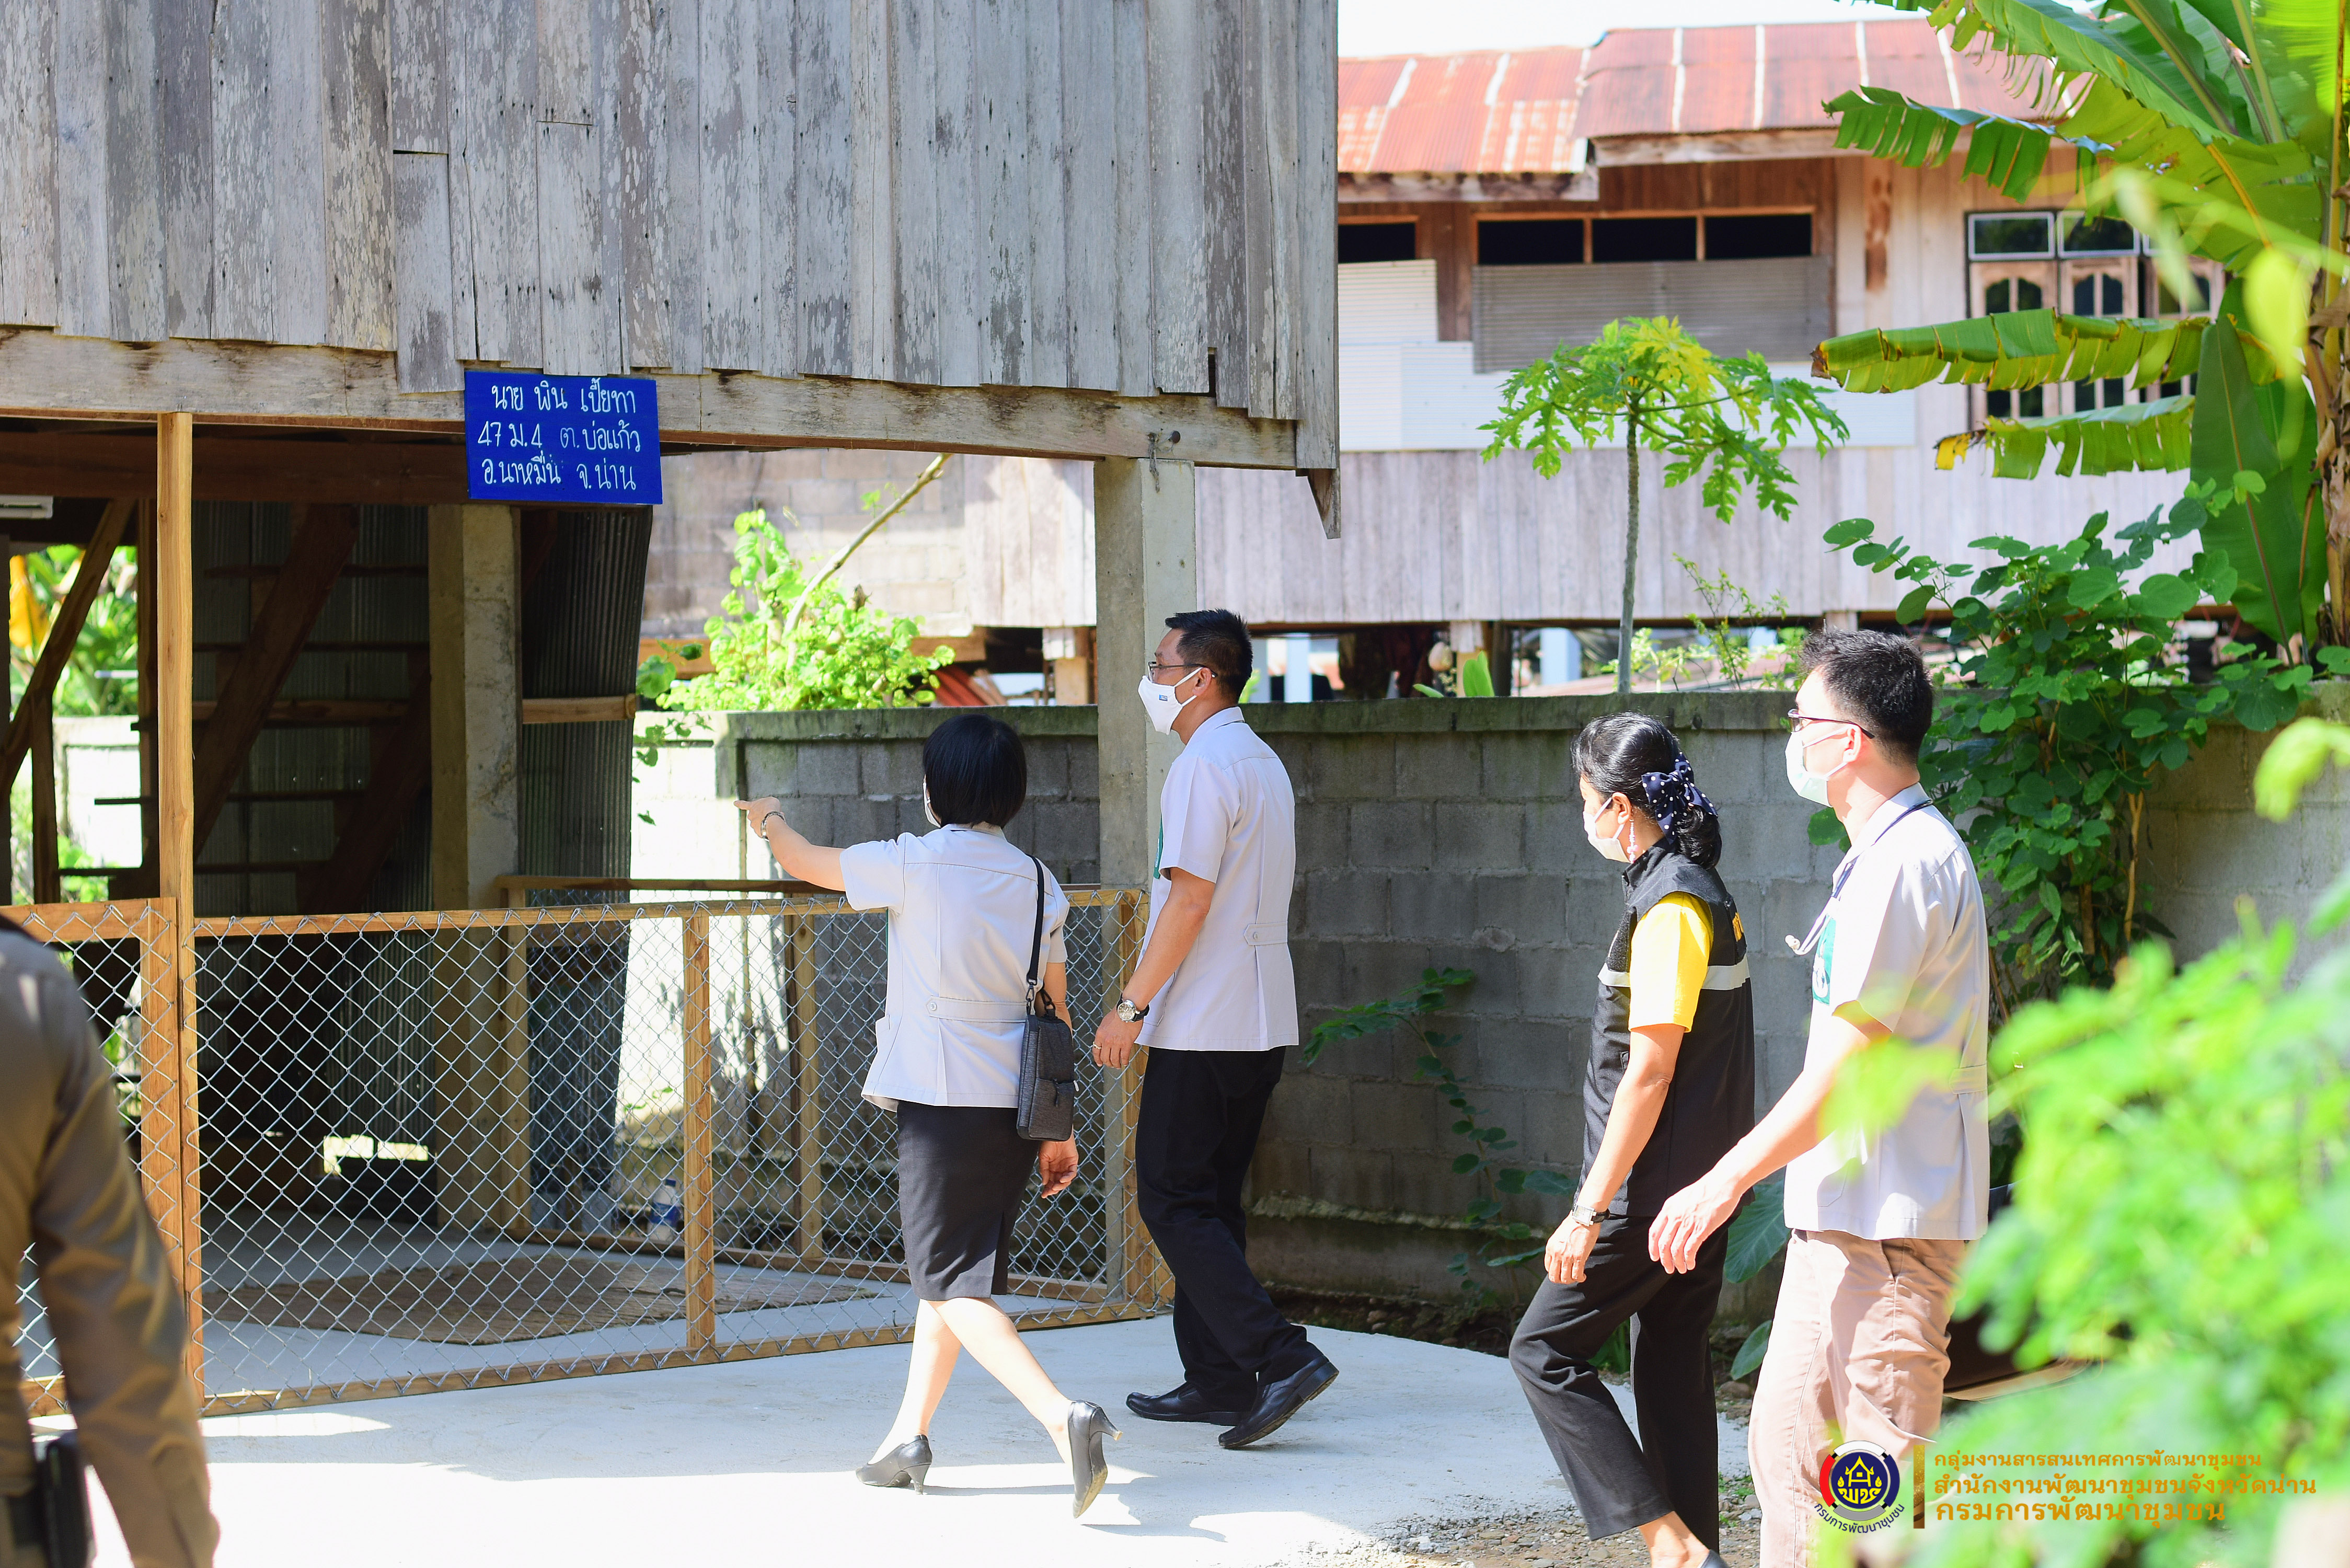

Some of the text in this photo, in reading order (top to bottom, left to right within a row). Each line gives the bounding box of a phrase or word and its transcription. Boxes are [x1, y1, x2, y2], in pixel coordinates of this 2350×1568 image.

[491, 385, 523, 411] นาย
[534, 380, 568, 411] พิน
[477, 419, 640, 452] 47 ม.4 ต.บ่อแก้ว
[481, 450, 636, 490] อ.นาหมื่น จ.น่าน
